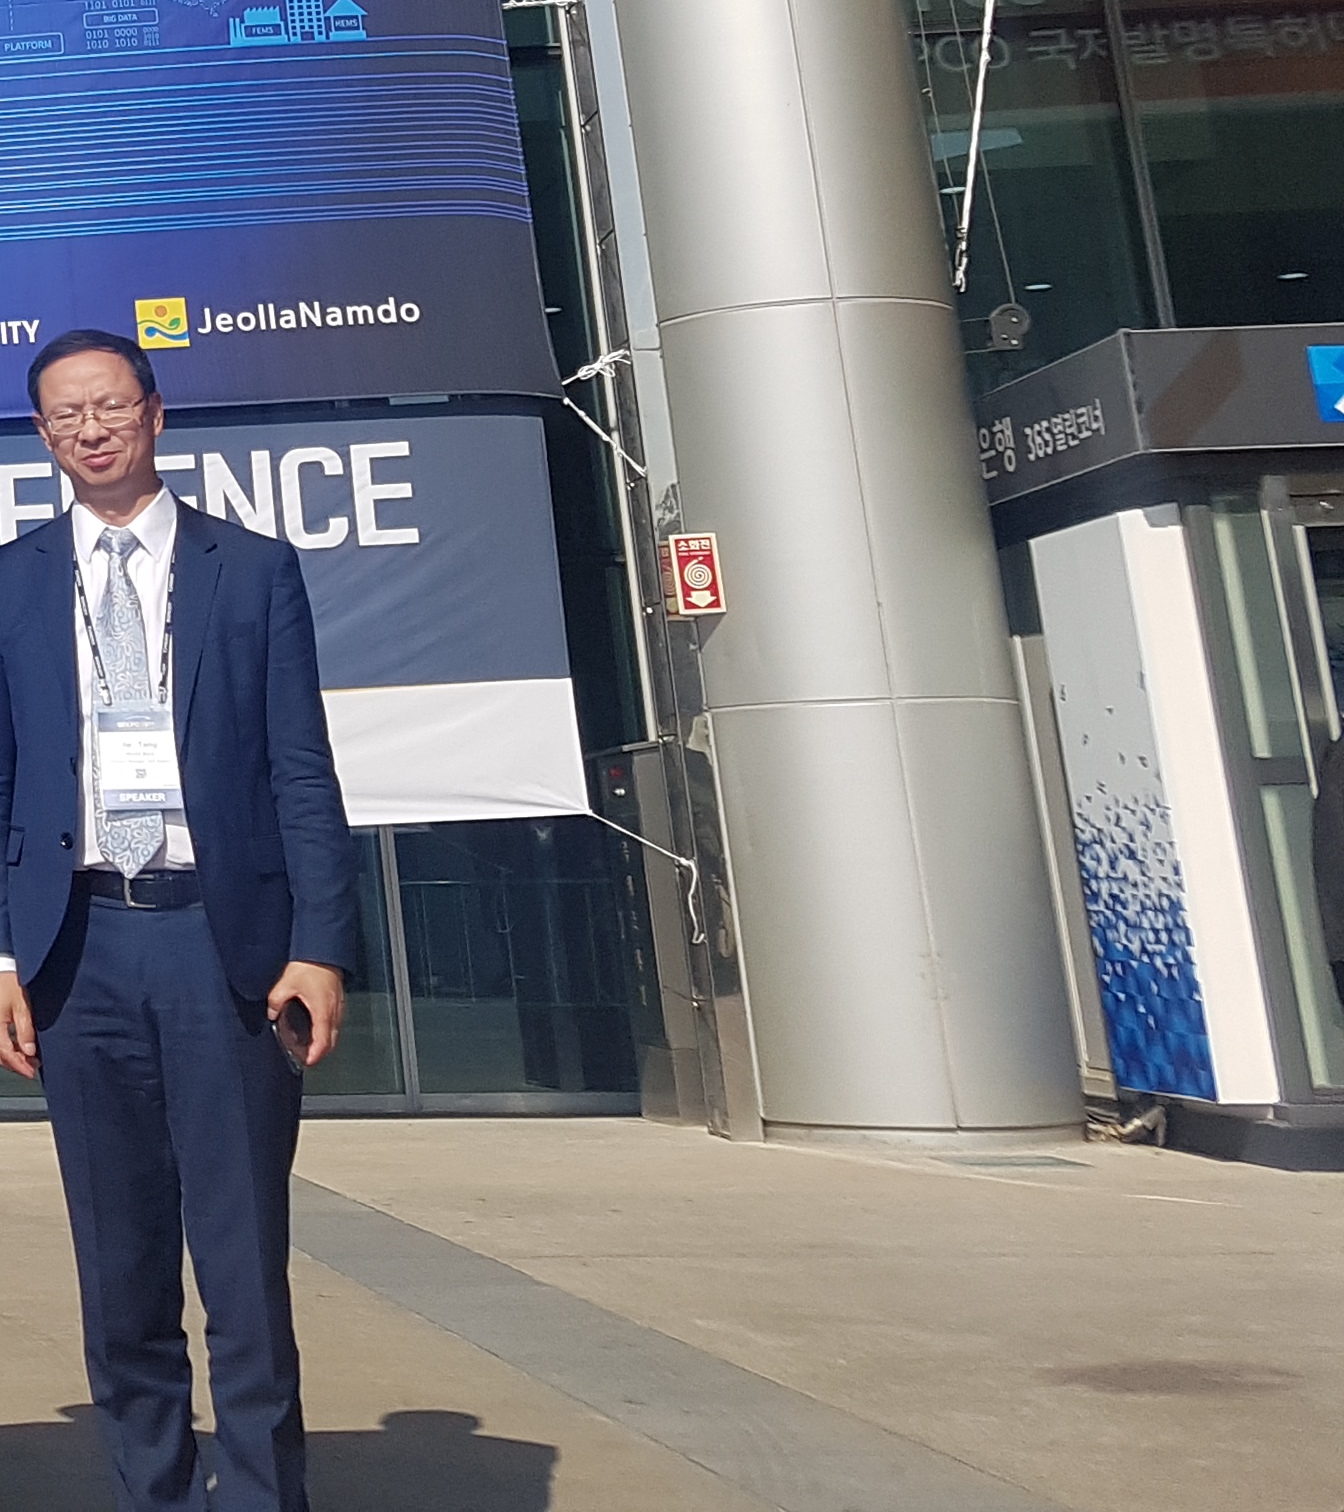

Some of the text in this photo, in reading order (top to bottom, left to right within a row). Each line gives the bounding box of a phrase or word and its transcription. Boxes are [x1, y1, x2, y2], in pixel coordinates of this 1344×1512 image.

[117, 13, 138, 22] DATA
[114, 27, 138, 37] 0000
[4, 40, 53, 52] PLATFORM
[197, 296, 421, 334] JeollaNamdo
[118, 792, 167, 803] SPEAKER
